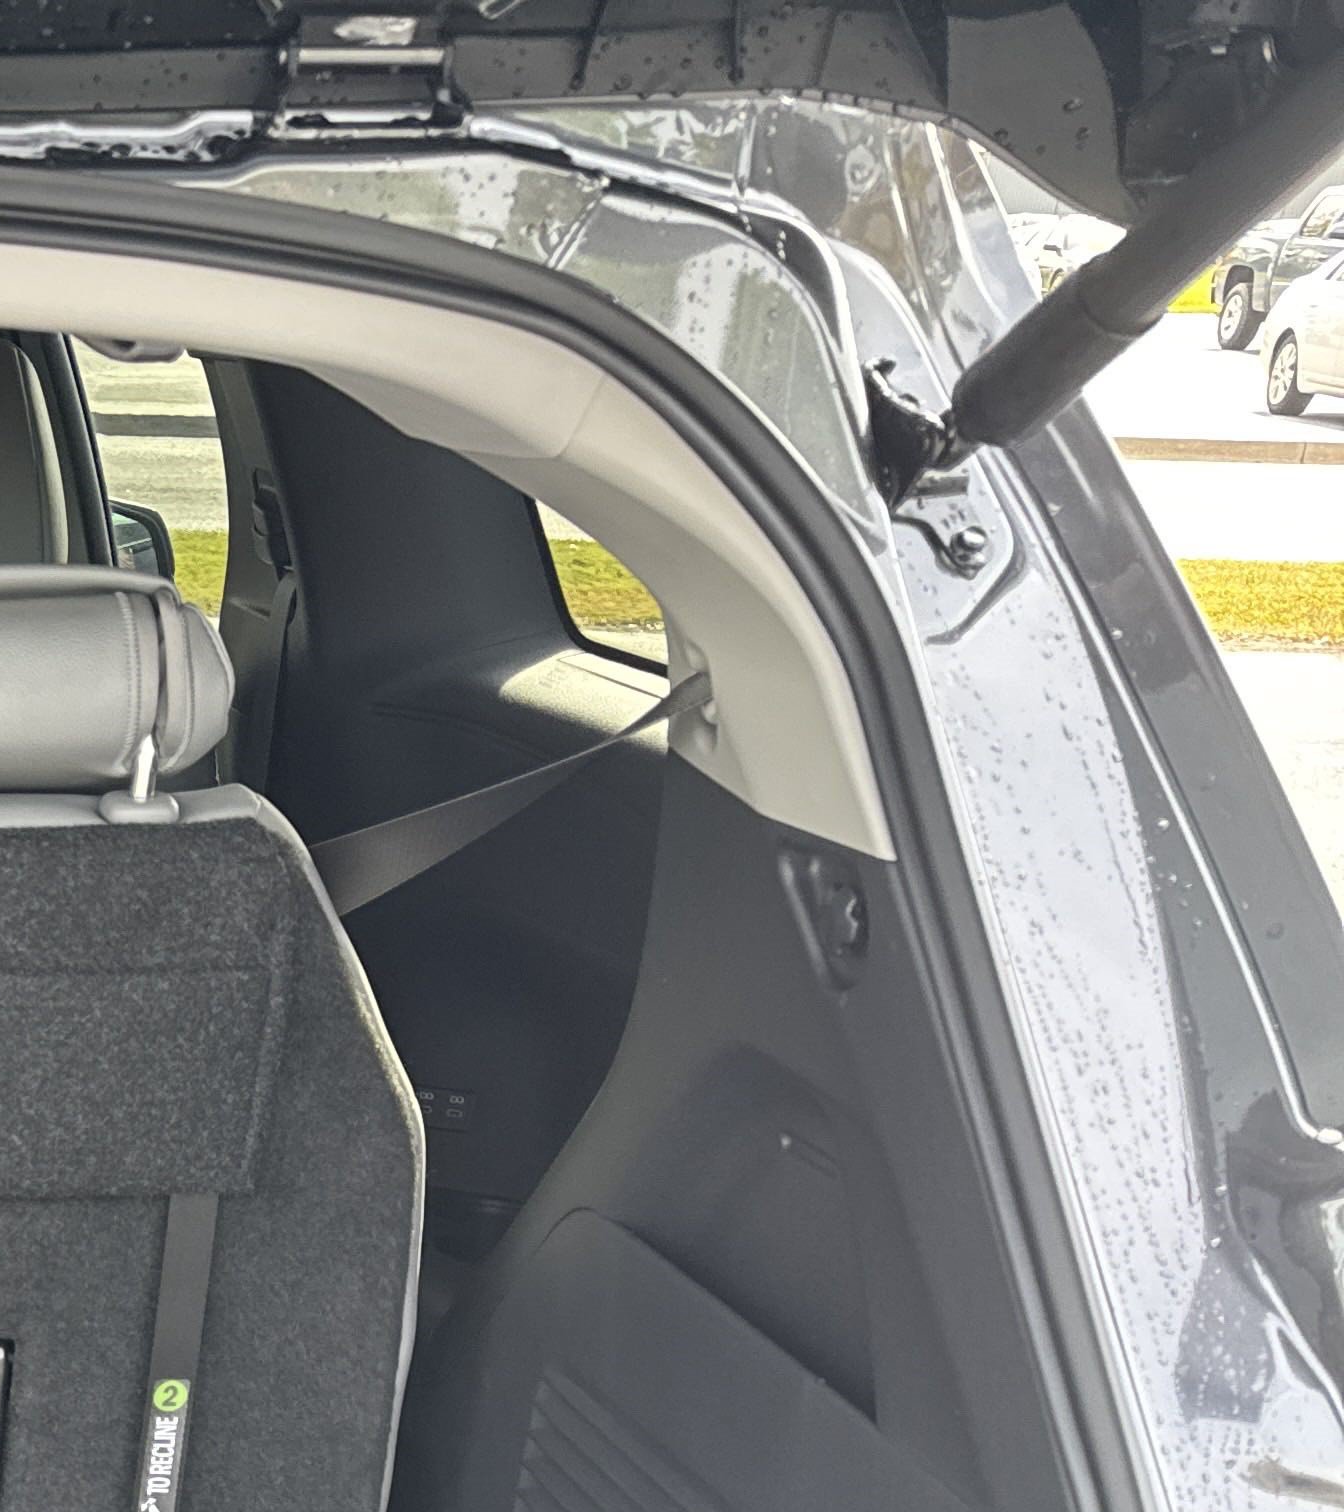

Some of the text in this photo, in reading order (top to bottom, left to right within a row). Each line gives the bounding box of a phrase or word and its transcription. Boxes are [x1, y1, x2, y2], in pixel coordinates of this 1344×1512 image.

[162, 1385, 179, 1407] 2
[146, 1416, 179, 1496] TO RECLINE
